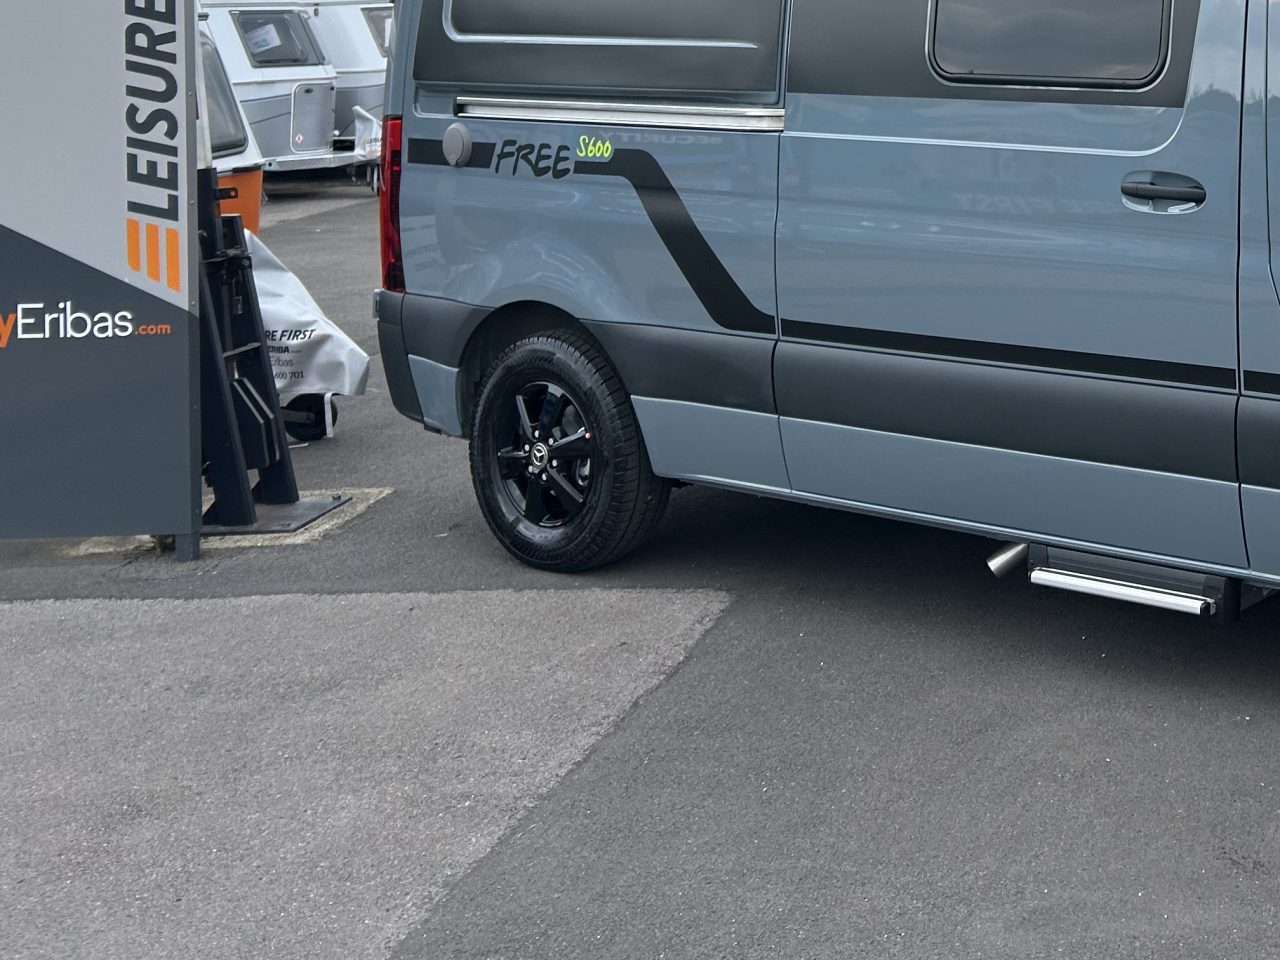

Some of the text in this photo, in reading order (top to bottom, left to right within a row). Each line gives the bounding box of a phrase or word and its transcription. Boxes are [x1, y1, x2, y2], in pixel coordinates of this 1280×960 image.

[494, 134, 613, 179] FREE S600
[279, 328, 317, 341] FIRST
